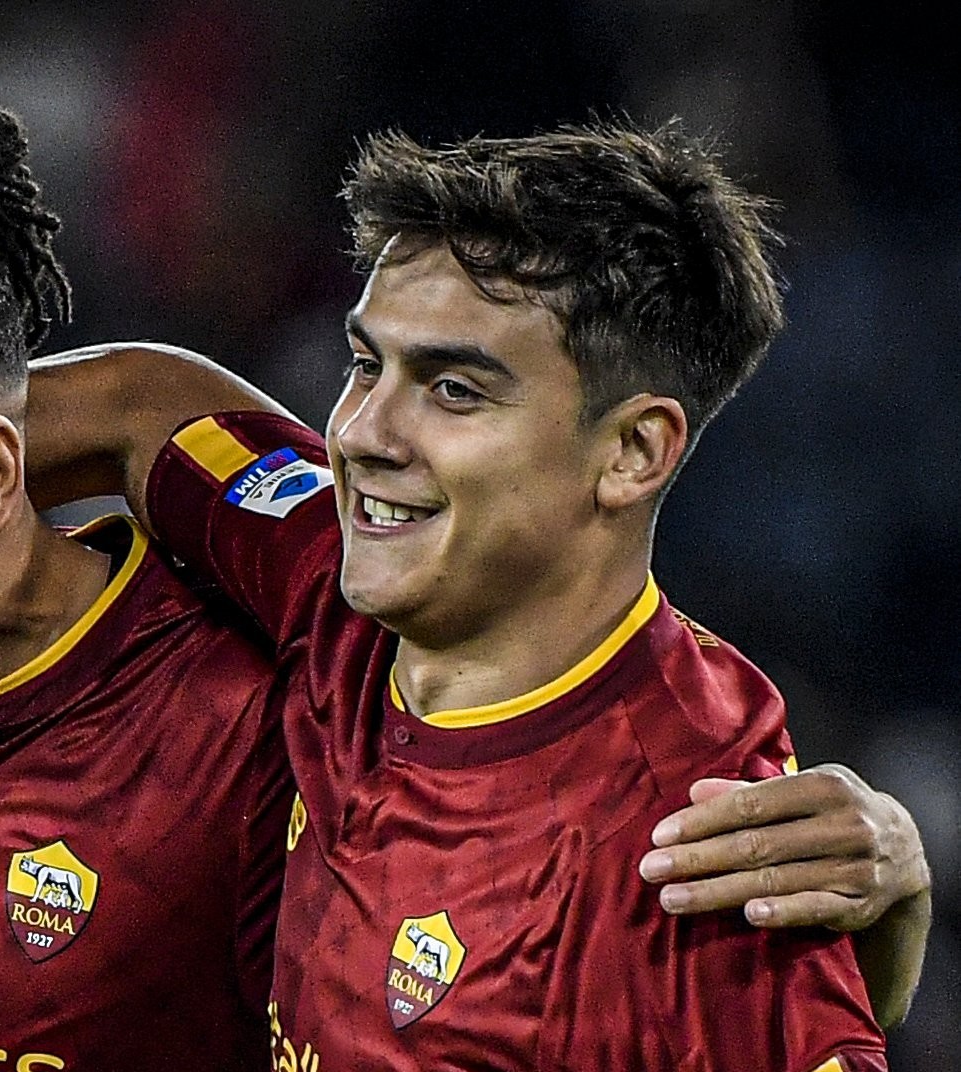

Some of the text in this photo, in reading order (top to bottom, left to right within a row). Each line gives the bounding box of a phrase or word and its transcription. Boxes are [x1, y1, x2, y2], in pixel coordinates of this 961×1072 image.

[235, 467, 270, 496] TIM
[11, 902, 76, 936] ROMA
[26, 932, 54, 948] 1927
[388, 968, 433, 1006] ROMA
